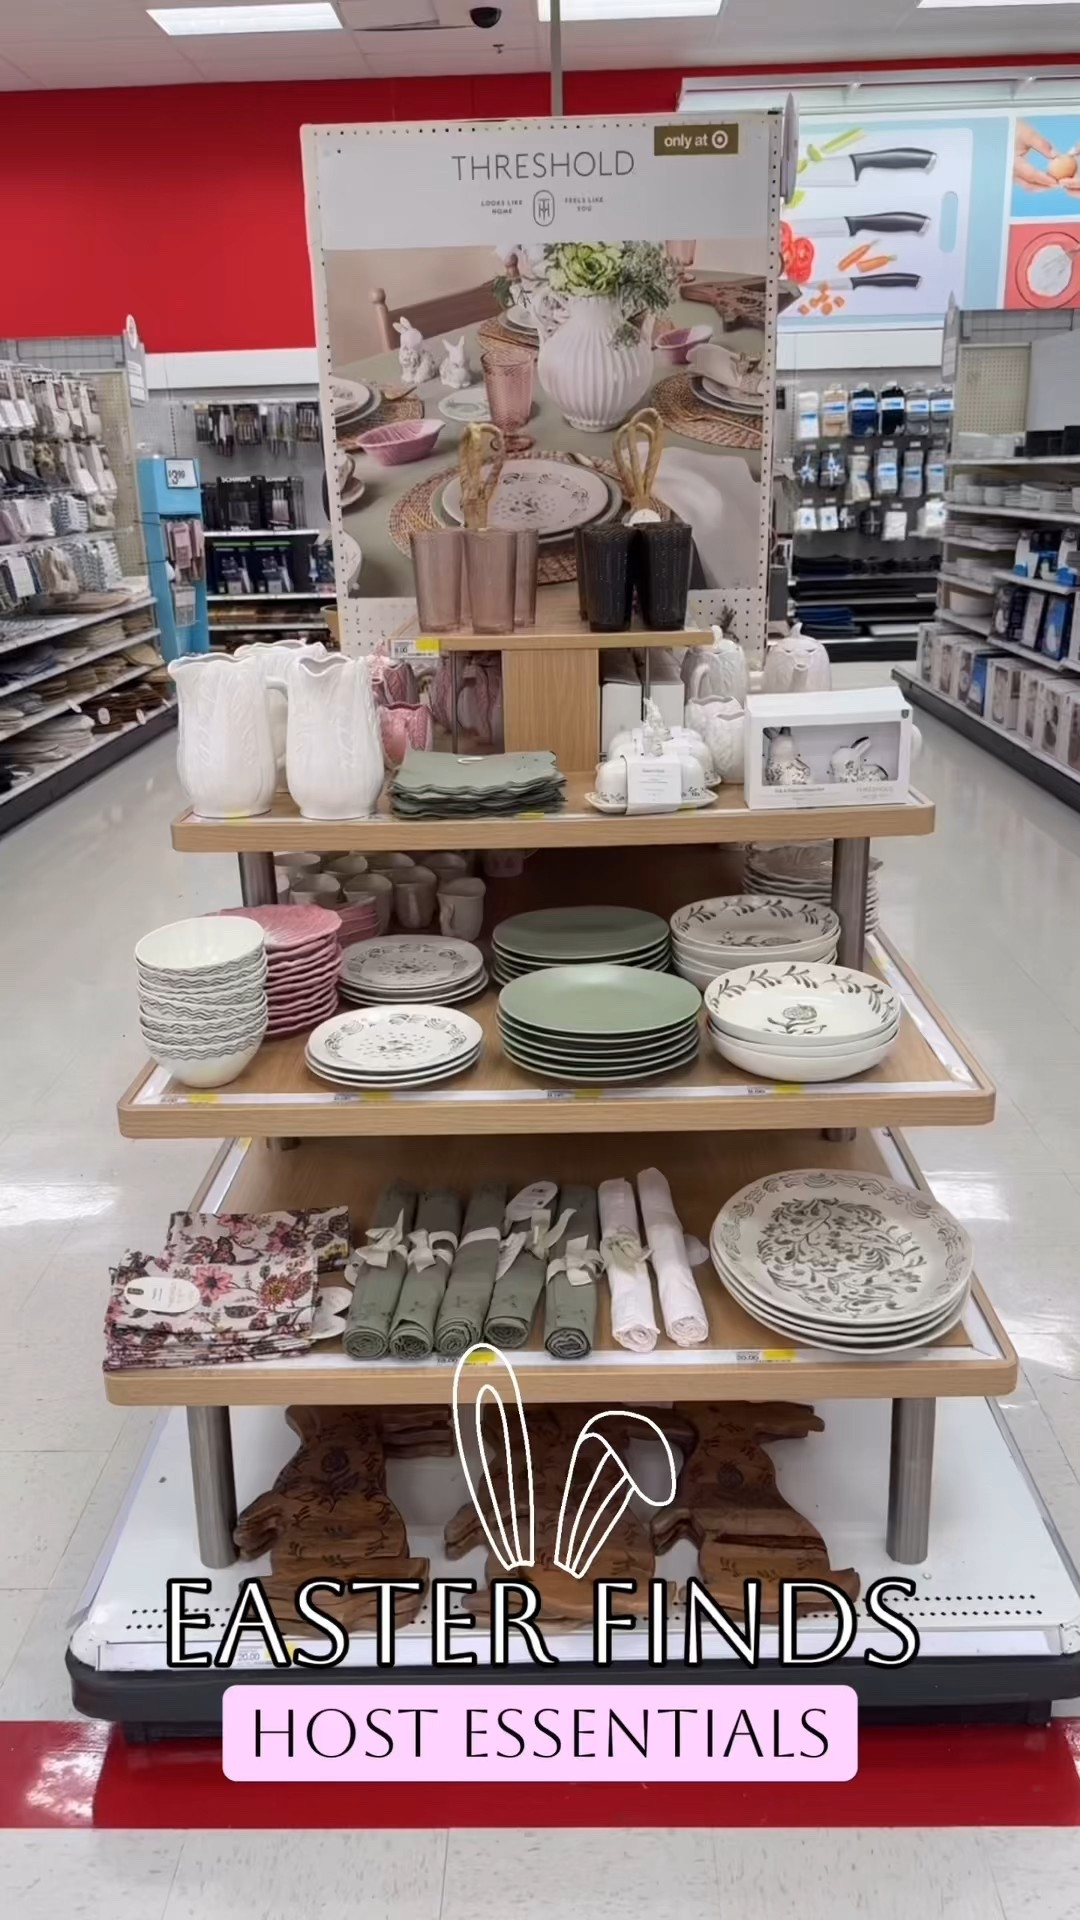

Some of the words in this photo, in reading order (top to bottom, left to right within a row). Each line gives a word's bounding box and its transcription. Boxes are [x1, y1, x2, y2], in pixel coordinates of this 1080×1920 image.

[664, 136, 692, 149] only
[694, 134, 708, 147] at
[451, 150, 635, 181] THRESHOLD
